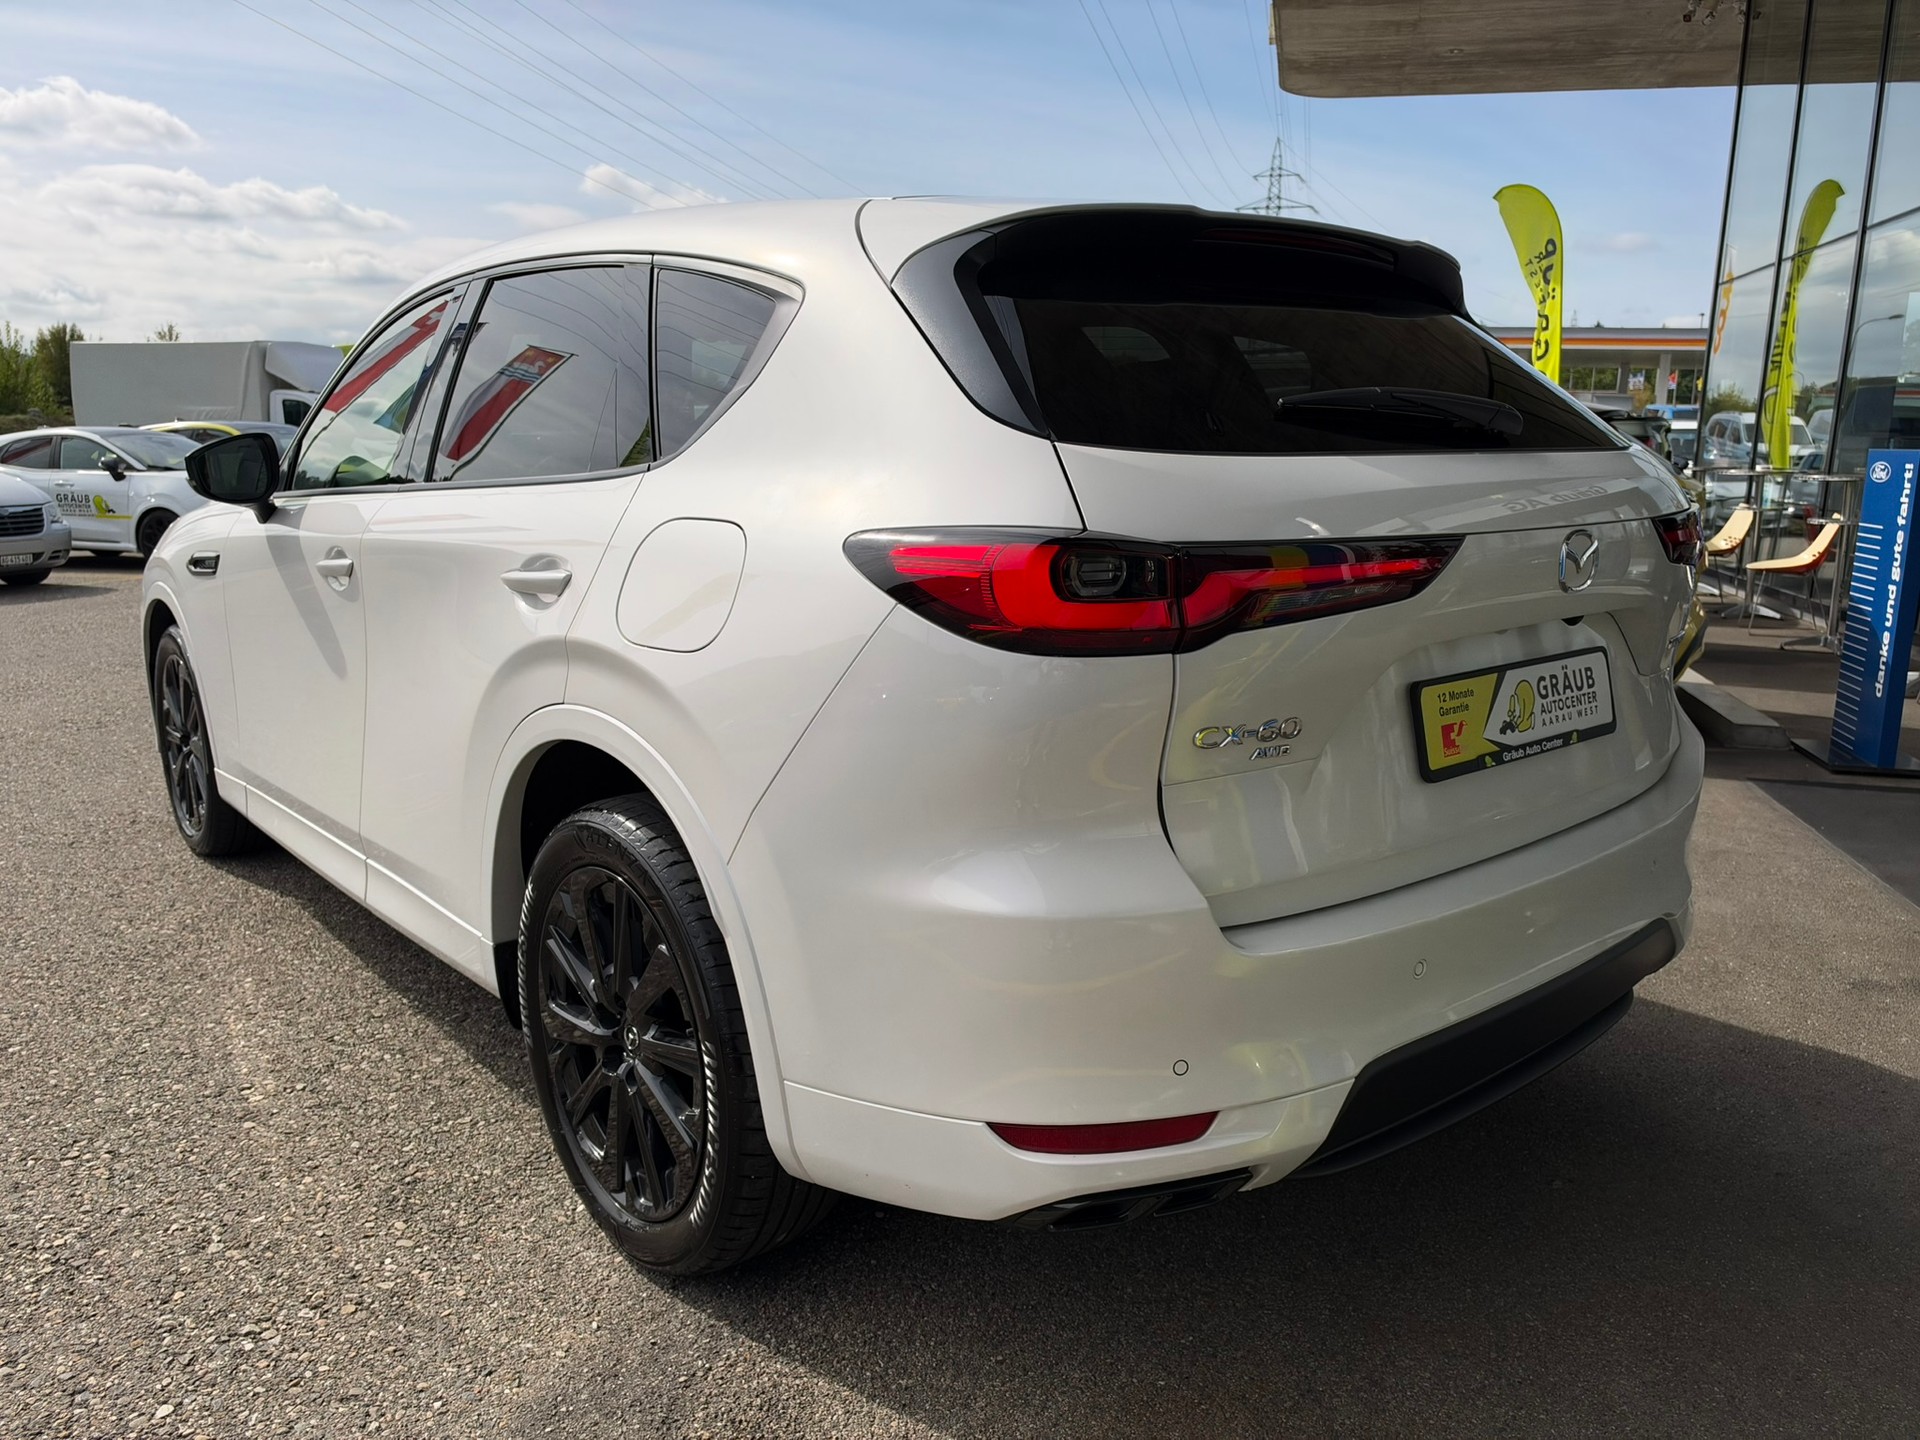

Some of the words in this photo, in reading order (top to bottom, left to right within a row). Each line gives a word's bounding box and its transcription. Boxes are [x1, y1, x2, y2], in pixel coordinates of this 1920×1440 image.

[56, 491, 90, 504] GRÄUB
[1896, 462, 1914, 528] fahrt!
[1890, 529, 1906, 582] gute
[1884, 584, 1897, 628] und
[1874, 630, 1891, 698] danke
[1437, 693, 1447, 704] 12
[1448, 687, 1475, 702] Monate
[1536, 664, 1596, 700] GRÄUB
[1438, 703, 1470, 717] Garantie
[1540, 690, 1598, 716] AUTOCENTER
[1541, 710, 1573, 727] AARAU
[1577, 705, 1599, 719] WEST
[1193, 716, 1303, 749] CX-60
[1502, 748, 1525, 762] Gräub
[1525, 745, 1541, 757] Auto
[1541, 738, 1564, 752] Center
[688, 1040, 720, 1229] BRIDGESTON
